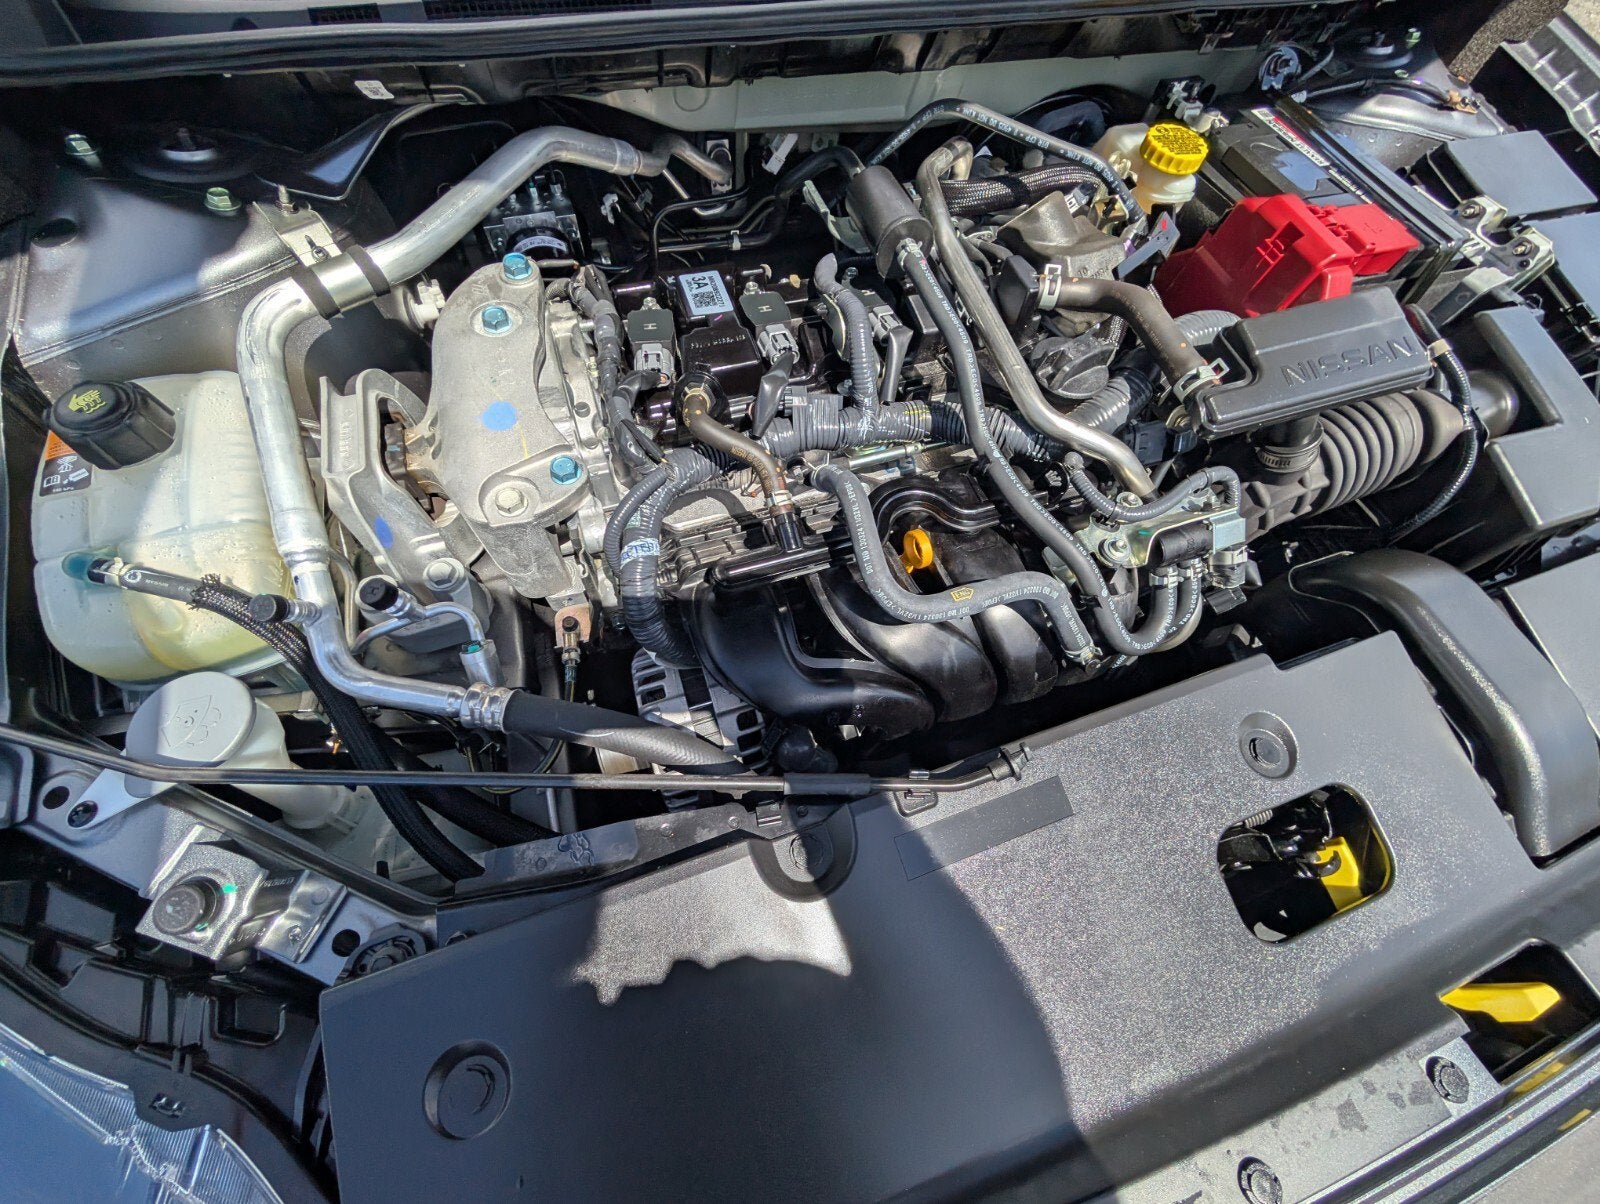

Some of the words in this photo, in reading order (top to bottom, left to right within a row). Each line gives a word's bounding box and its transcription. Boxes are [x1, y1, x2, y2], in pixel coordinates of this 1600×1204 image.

[691, 275, 706, 290] 3A
[757, 304, 773, 313] H
[643, 322, 657, 331] H
[1280, 336, 1413, 388] NISSAN
